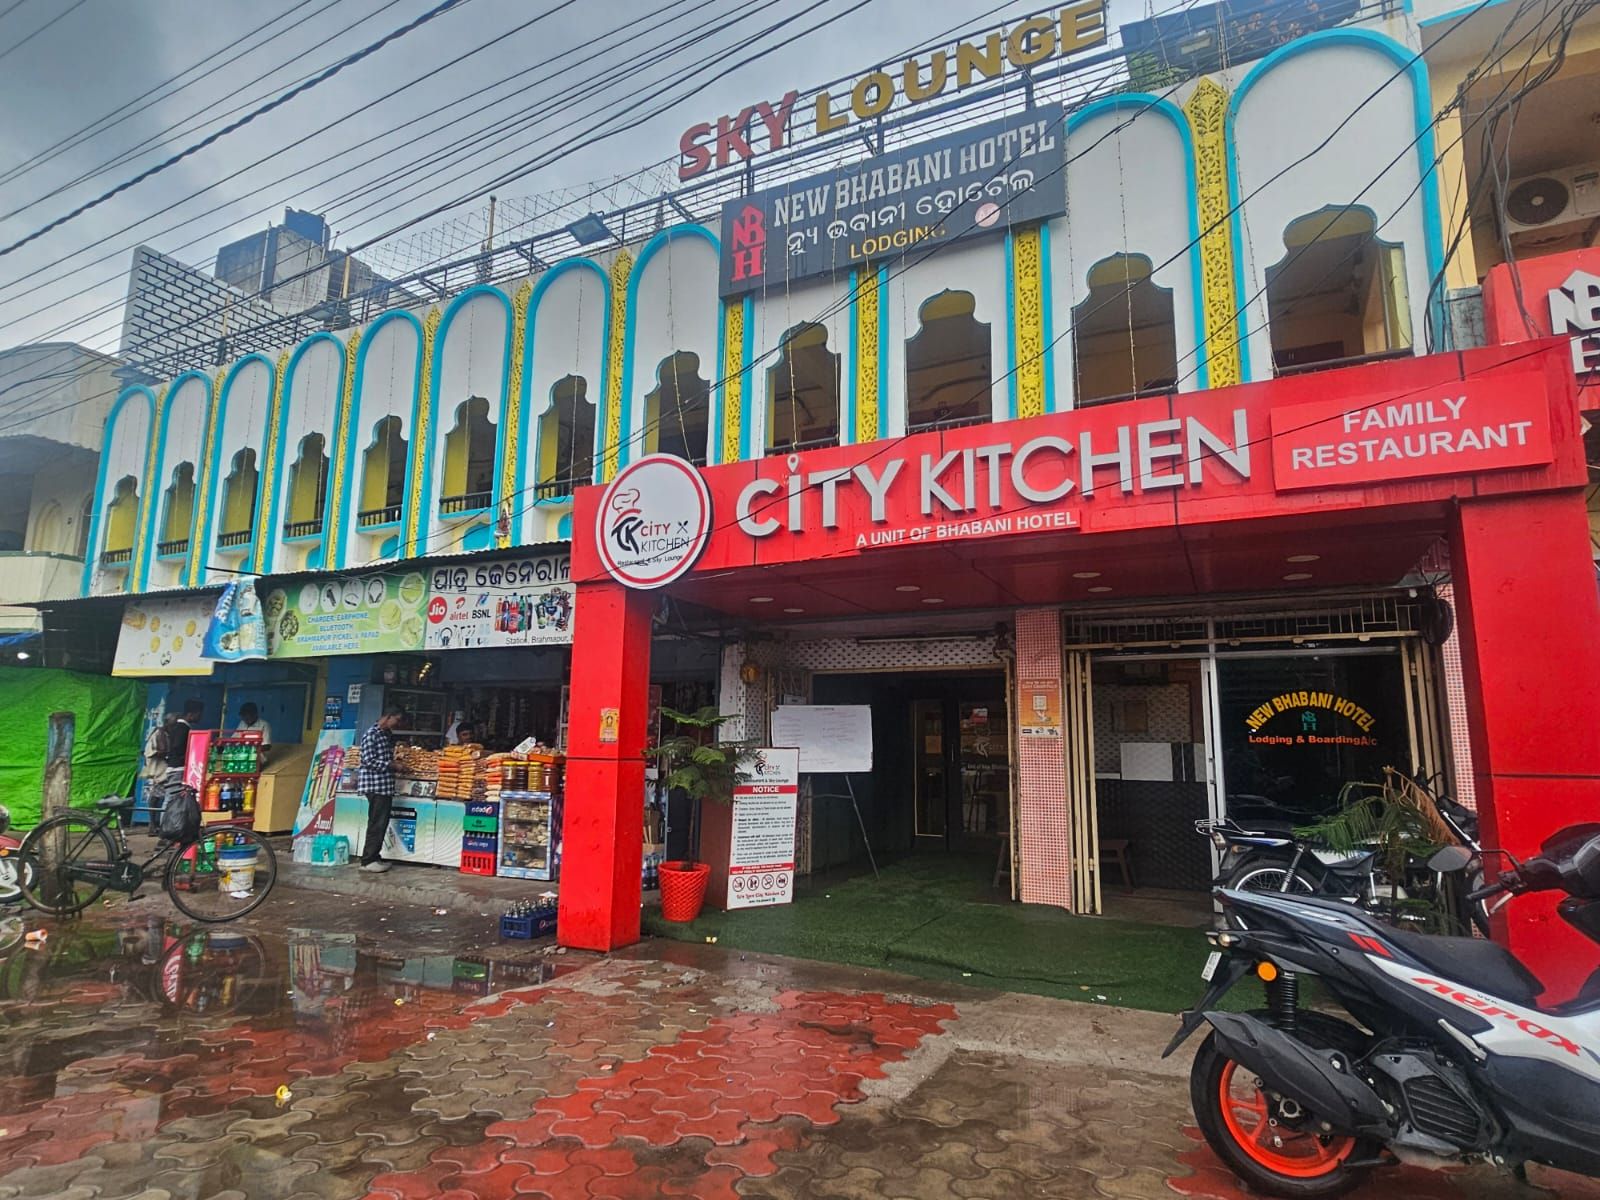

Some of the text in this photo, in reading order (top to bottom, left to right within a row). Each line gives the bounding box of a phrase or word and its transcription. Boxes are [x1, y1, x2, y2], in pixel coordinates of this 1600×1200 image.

[679, 3, 1107, 182] SKY LOUNGE
[773, 119, 1055, 227] NEW BHABANI HOTEL
[1343, 396, 1467, 433] FAMILY
[920, 409, 1251, 515] KITCHEN
[1291, 421, 1533, 470] RESTAURANT
[640, 537, 690, 553] KITCHEN
[856, 511, 1077, 547] A UNIT OF BHABANI HOTEL
[429, 603, 445, 616] Jio
[449, 609, 492, 621] airtel BSNL
[319, 624, 353, 632] BLUETOOTH
[1245, 691, 1376, 732] NEW BHABANI HOTEL
[1249, 735, 1293, 745] Lodging
[1296, 735, 1304, 744] &
[1308, 735, 1361, 746] Boarding
